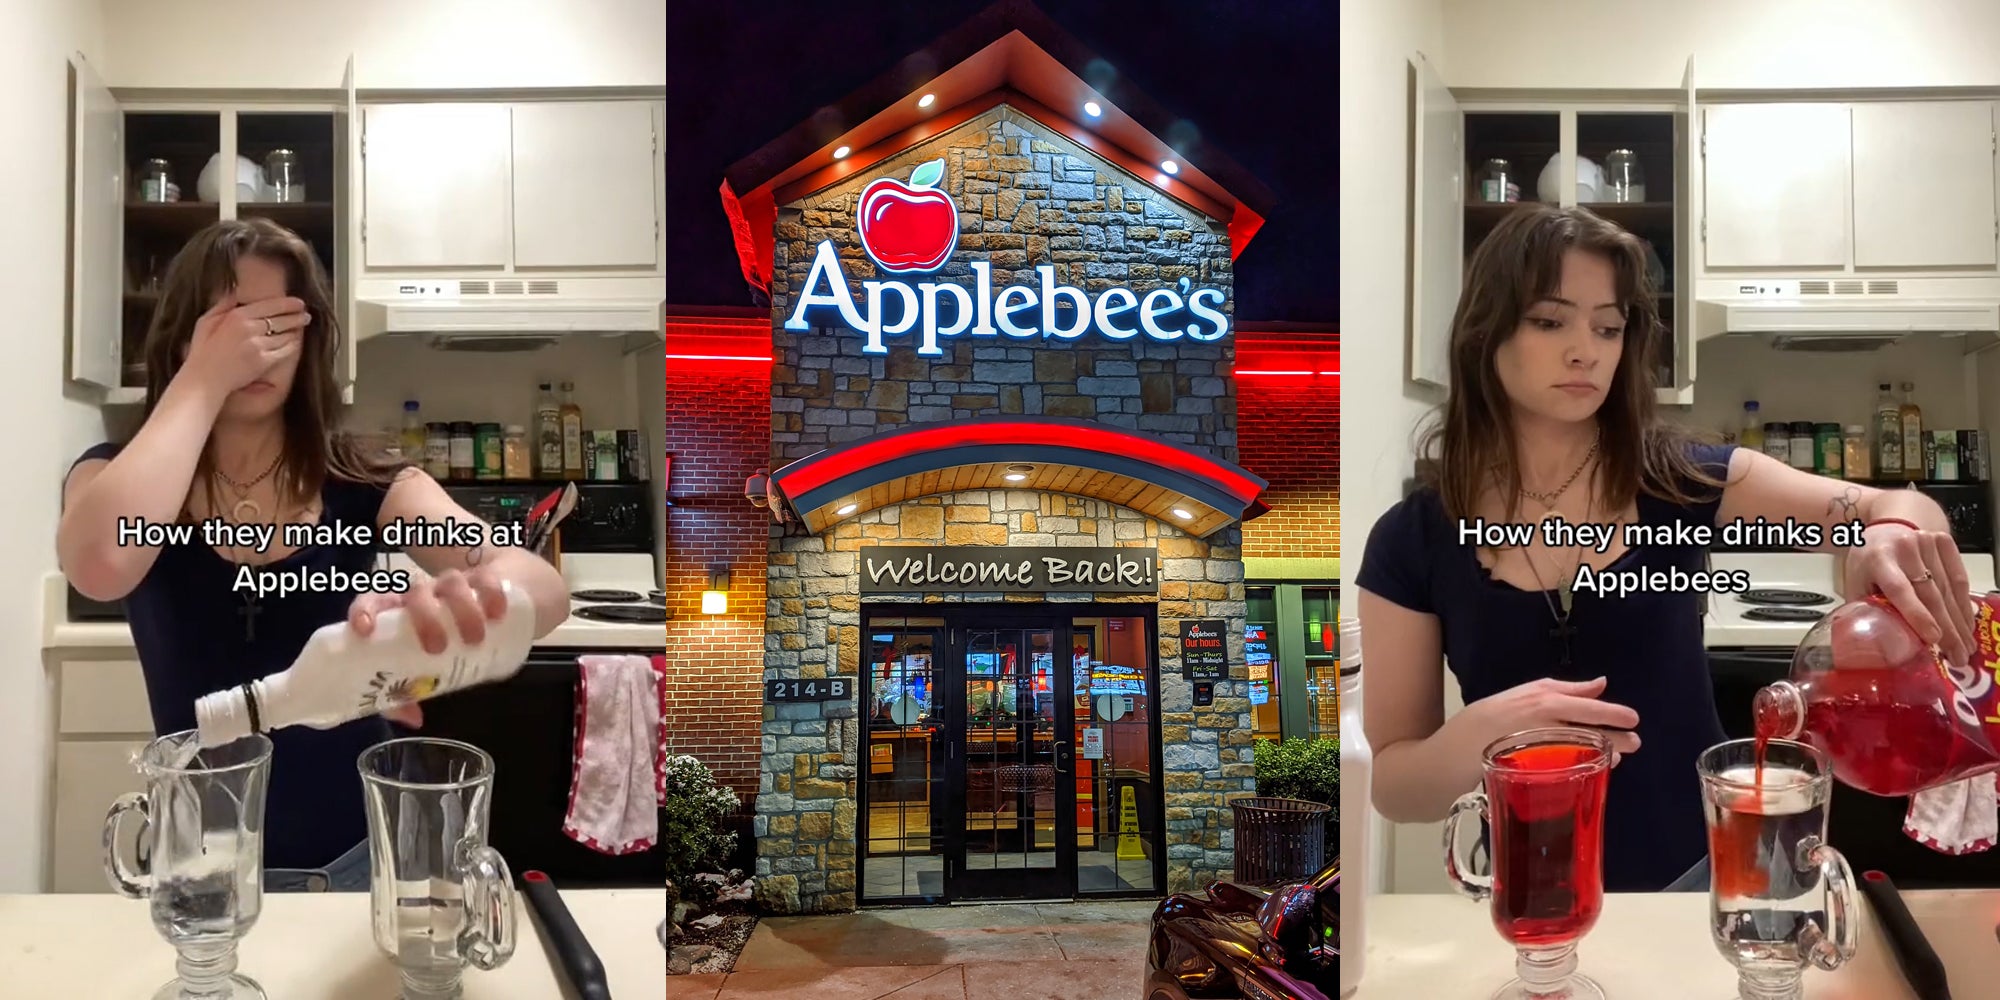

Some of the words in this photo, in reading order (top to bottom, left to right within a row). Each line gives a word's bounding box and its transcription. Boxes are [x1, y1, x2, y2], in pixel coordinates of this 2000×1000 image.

[784, 239, 1229, 355] Applebee's
[866, 553, 1034, 585] Welcome
[1041, 553, 1153, 586] Back!
[1186, 639, 1198, 647] Our
[774, 681, 845, 697] 214-B
